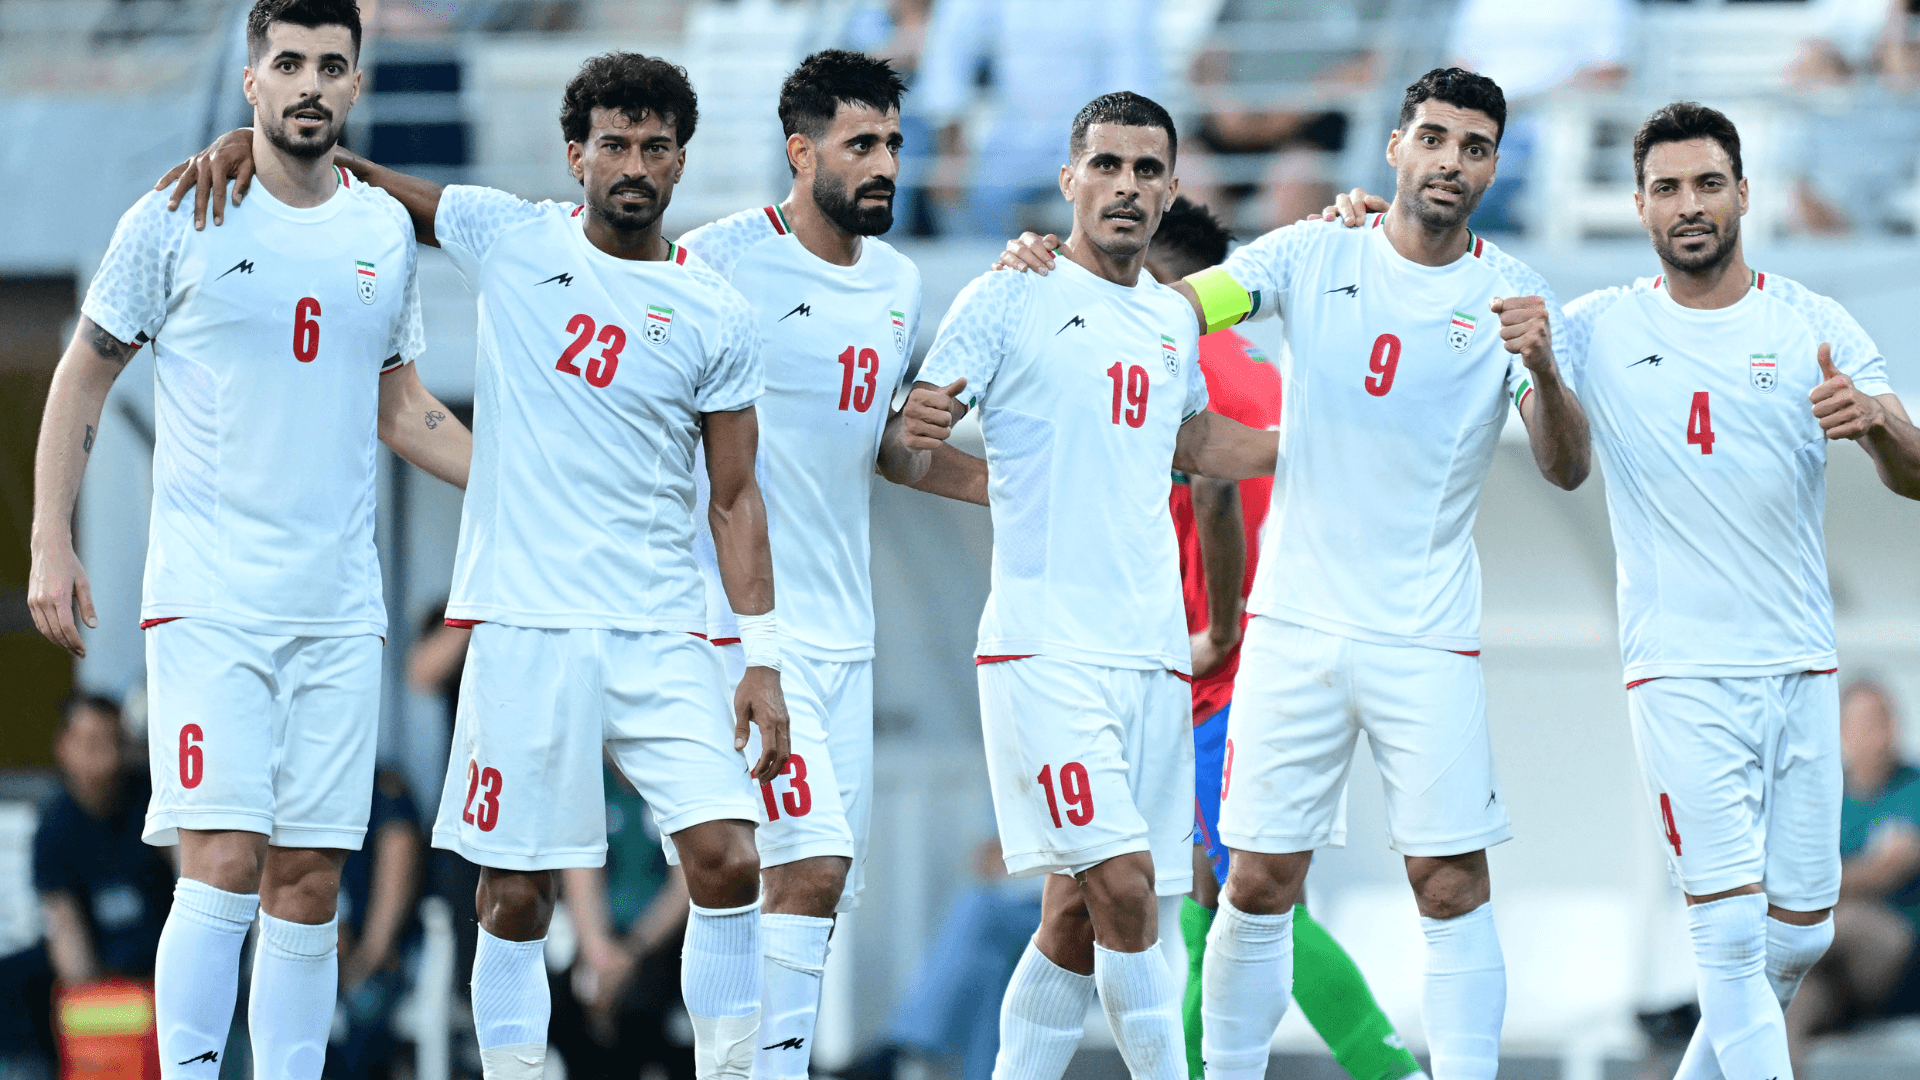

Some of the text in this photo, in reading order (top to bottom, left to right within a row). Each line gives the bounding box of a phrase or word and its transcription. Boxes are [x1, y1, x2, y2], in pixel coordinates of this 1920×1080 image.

[293, 296, 322, 363] 6
[555, 313, 627, 389] 23
[838, 345, 880, 413] 13
[1106, 361, 1150, 429] 19
[1364, 333, 1402, 397] 9
[1687, 391, 1716, 455] 4
[178, 723, 204, 790] 6
[750, 753, 812, 822] 13
[462, 758, 503, 832] 23
[1037, 761, 1095, 829] 19
[1660, 793, 1682, 856] 4
